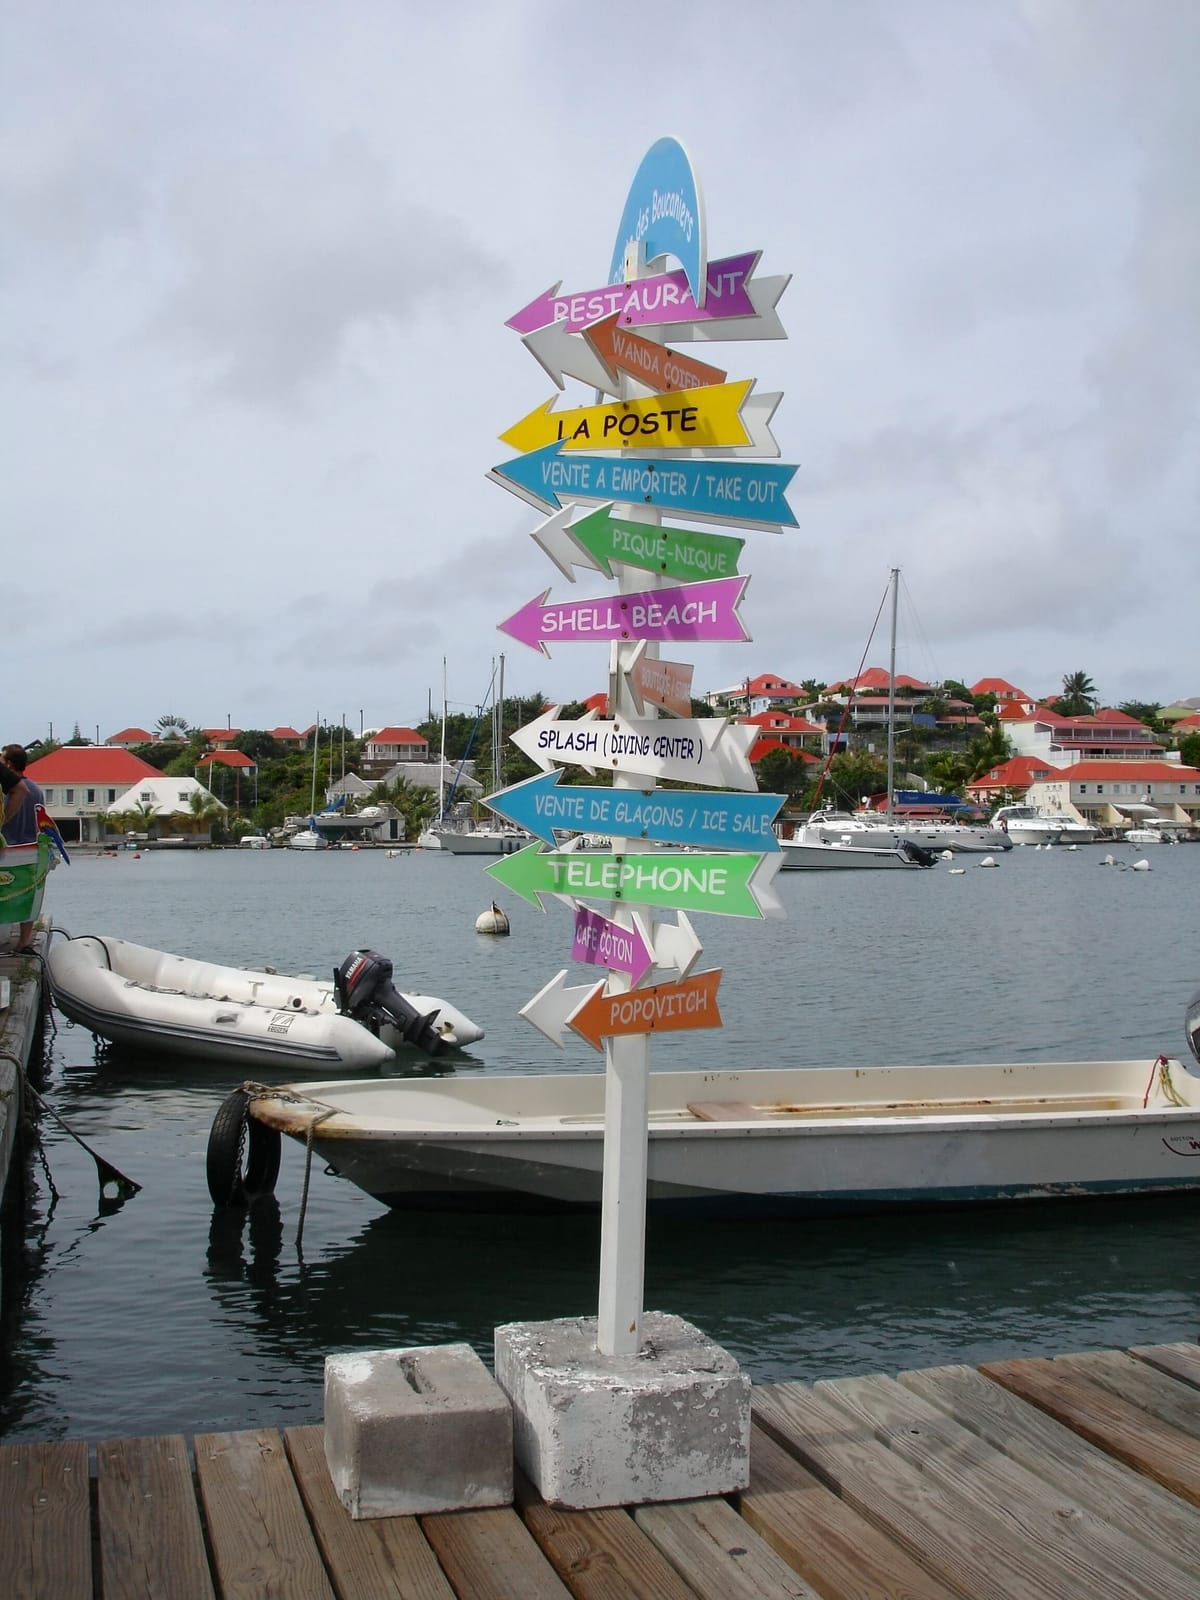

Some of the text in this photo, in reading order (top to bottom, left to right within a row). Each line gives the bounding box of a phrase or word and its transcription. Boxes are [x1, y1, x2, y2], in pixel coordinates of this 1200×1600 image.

[636, 188, 693, 243] des Boucaniers
[612, 331, 659, 375] WANDA
[558, 407, 698, 440] LA POSTE
[541, 462, 591, 488] VENTE
[595, 469, 606, 488] A
[612, 467, 687, 496] EMPORTER
[706, 475, 742, 501] TAKE
[747, 480, 778, 503] OUT
[613, 529, 727, 573] PIQUE-NIQUE
[541, 601, 717, 632] SHELL BEACH
[538, 730, 598, 753] SPLASH
[535, 794, 585, 819] VENTE
[590, 799, 610, 822] DE
[615, 802, 684, 829] GLAÇONS
[701, 810, 727, 832] ICE
[732, 814, 771, 835] SALE
[547, 860, 728, 895] TELEPHONE
[576, 925, 633, 964] CAFE COTON
[345, 957, 363, 979] YAMAHA
[610, 989, 707, 1026] POPOVITCH
